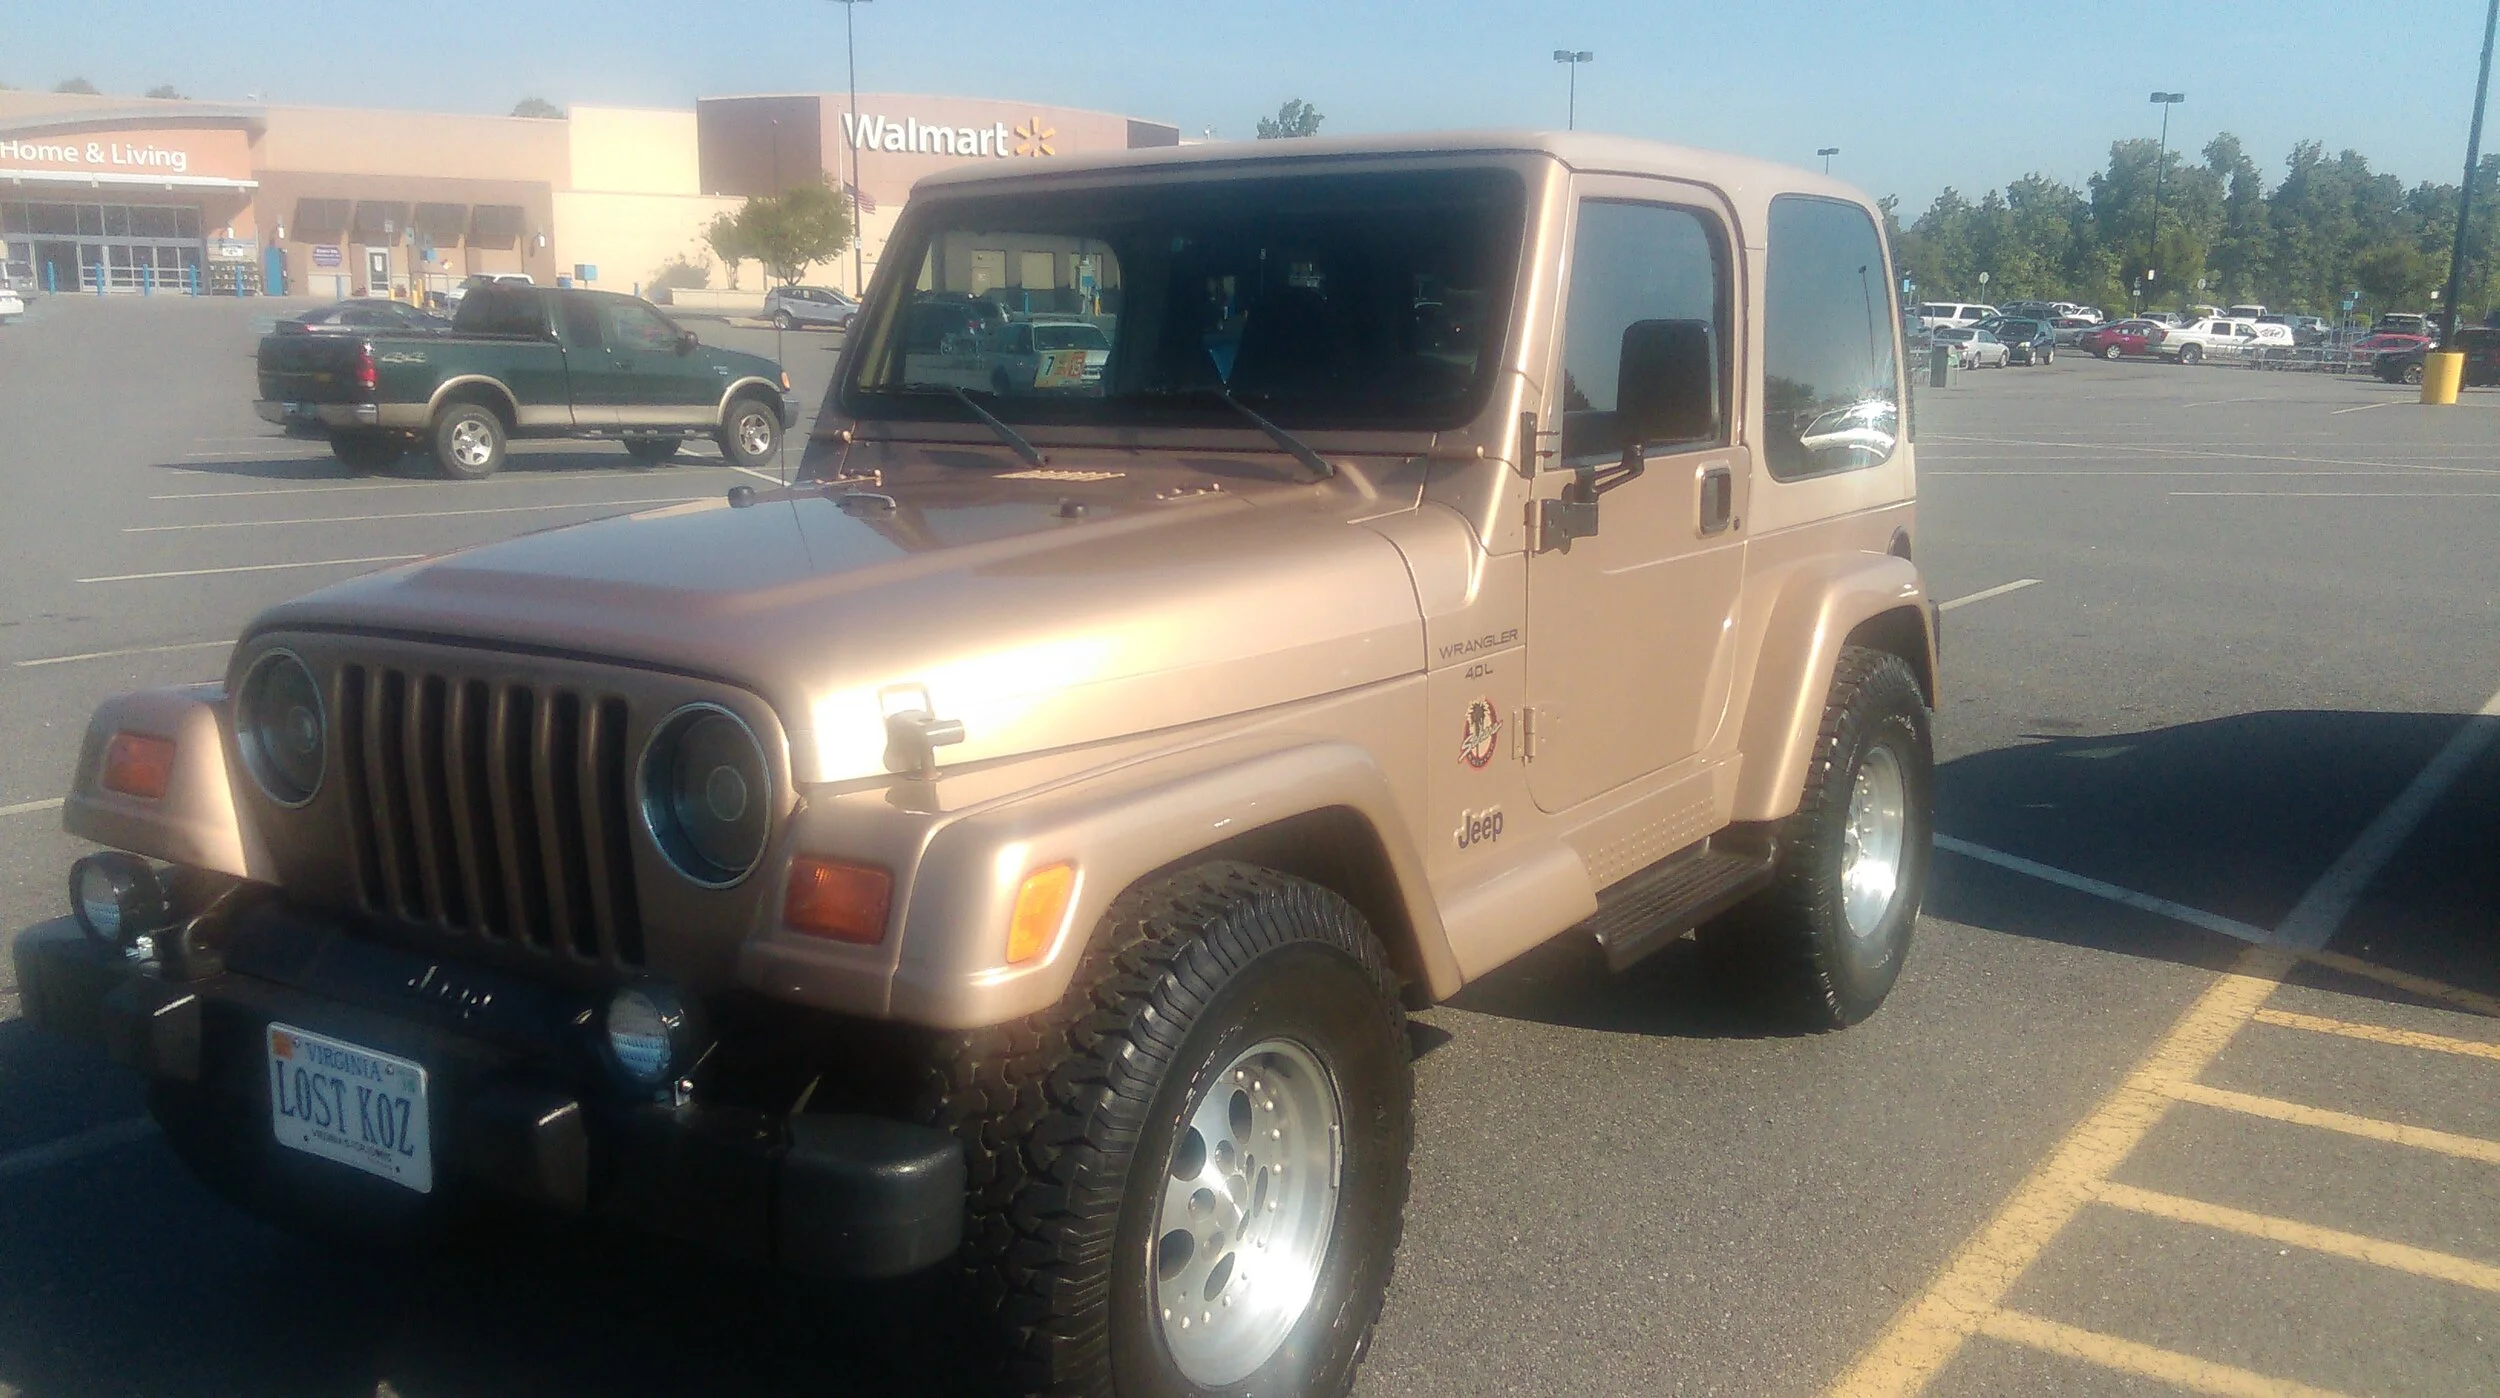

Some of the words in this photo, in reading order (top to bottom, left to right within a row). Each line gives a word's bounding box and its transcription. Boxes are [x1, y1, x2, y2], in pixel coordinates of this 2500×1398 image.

[842, 112, 1010, 157] Walmart
[0, 140, 79, 163] Home
[84, 142, 105, 164] &
[111, 143, 187, 173] Living
[1438, 628, 1519, 660] WRANGLER
[1457, 811, 1504, 849] Jeep
[304, 1042, 383, 1082] VIRGINIA
[275, 1059, 347, 1134] LOST
